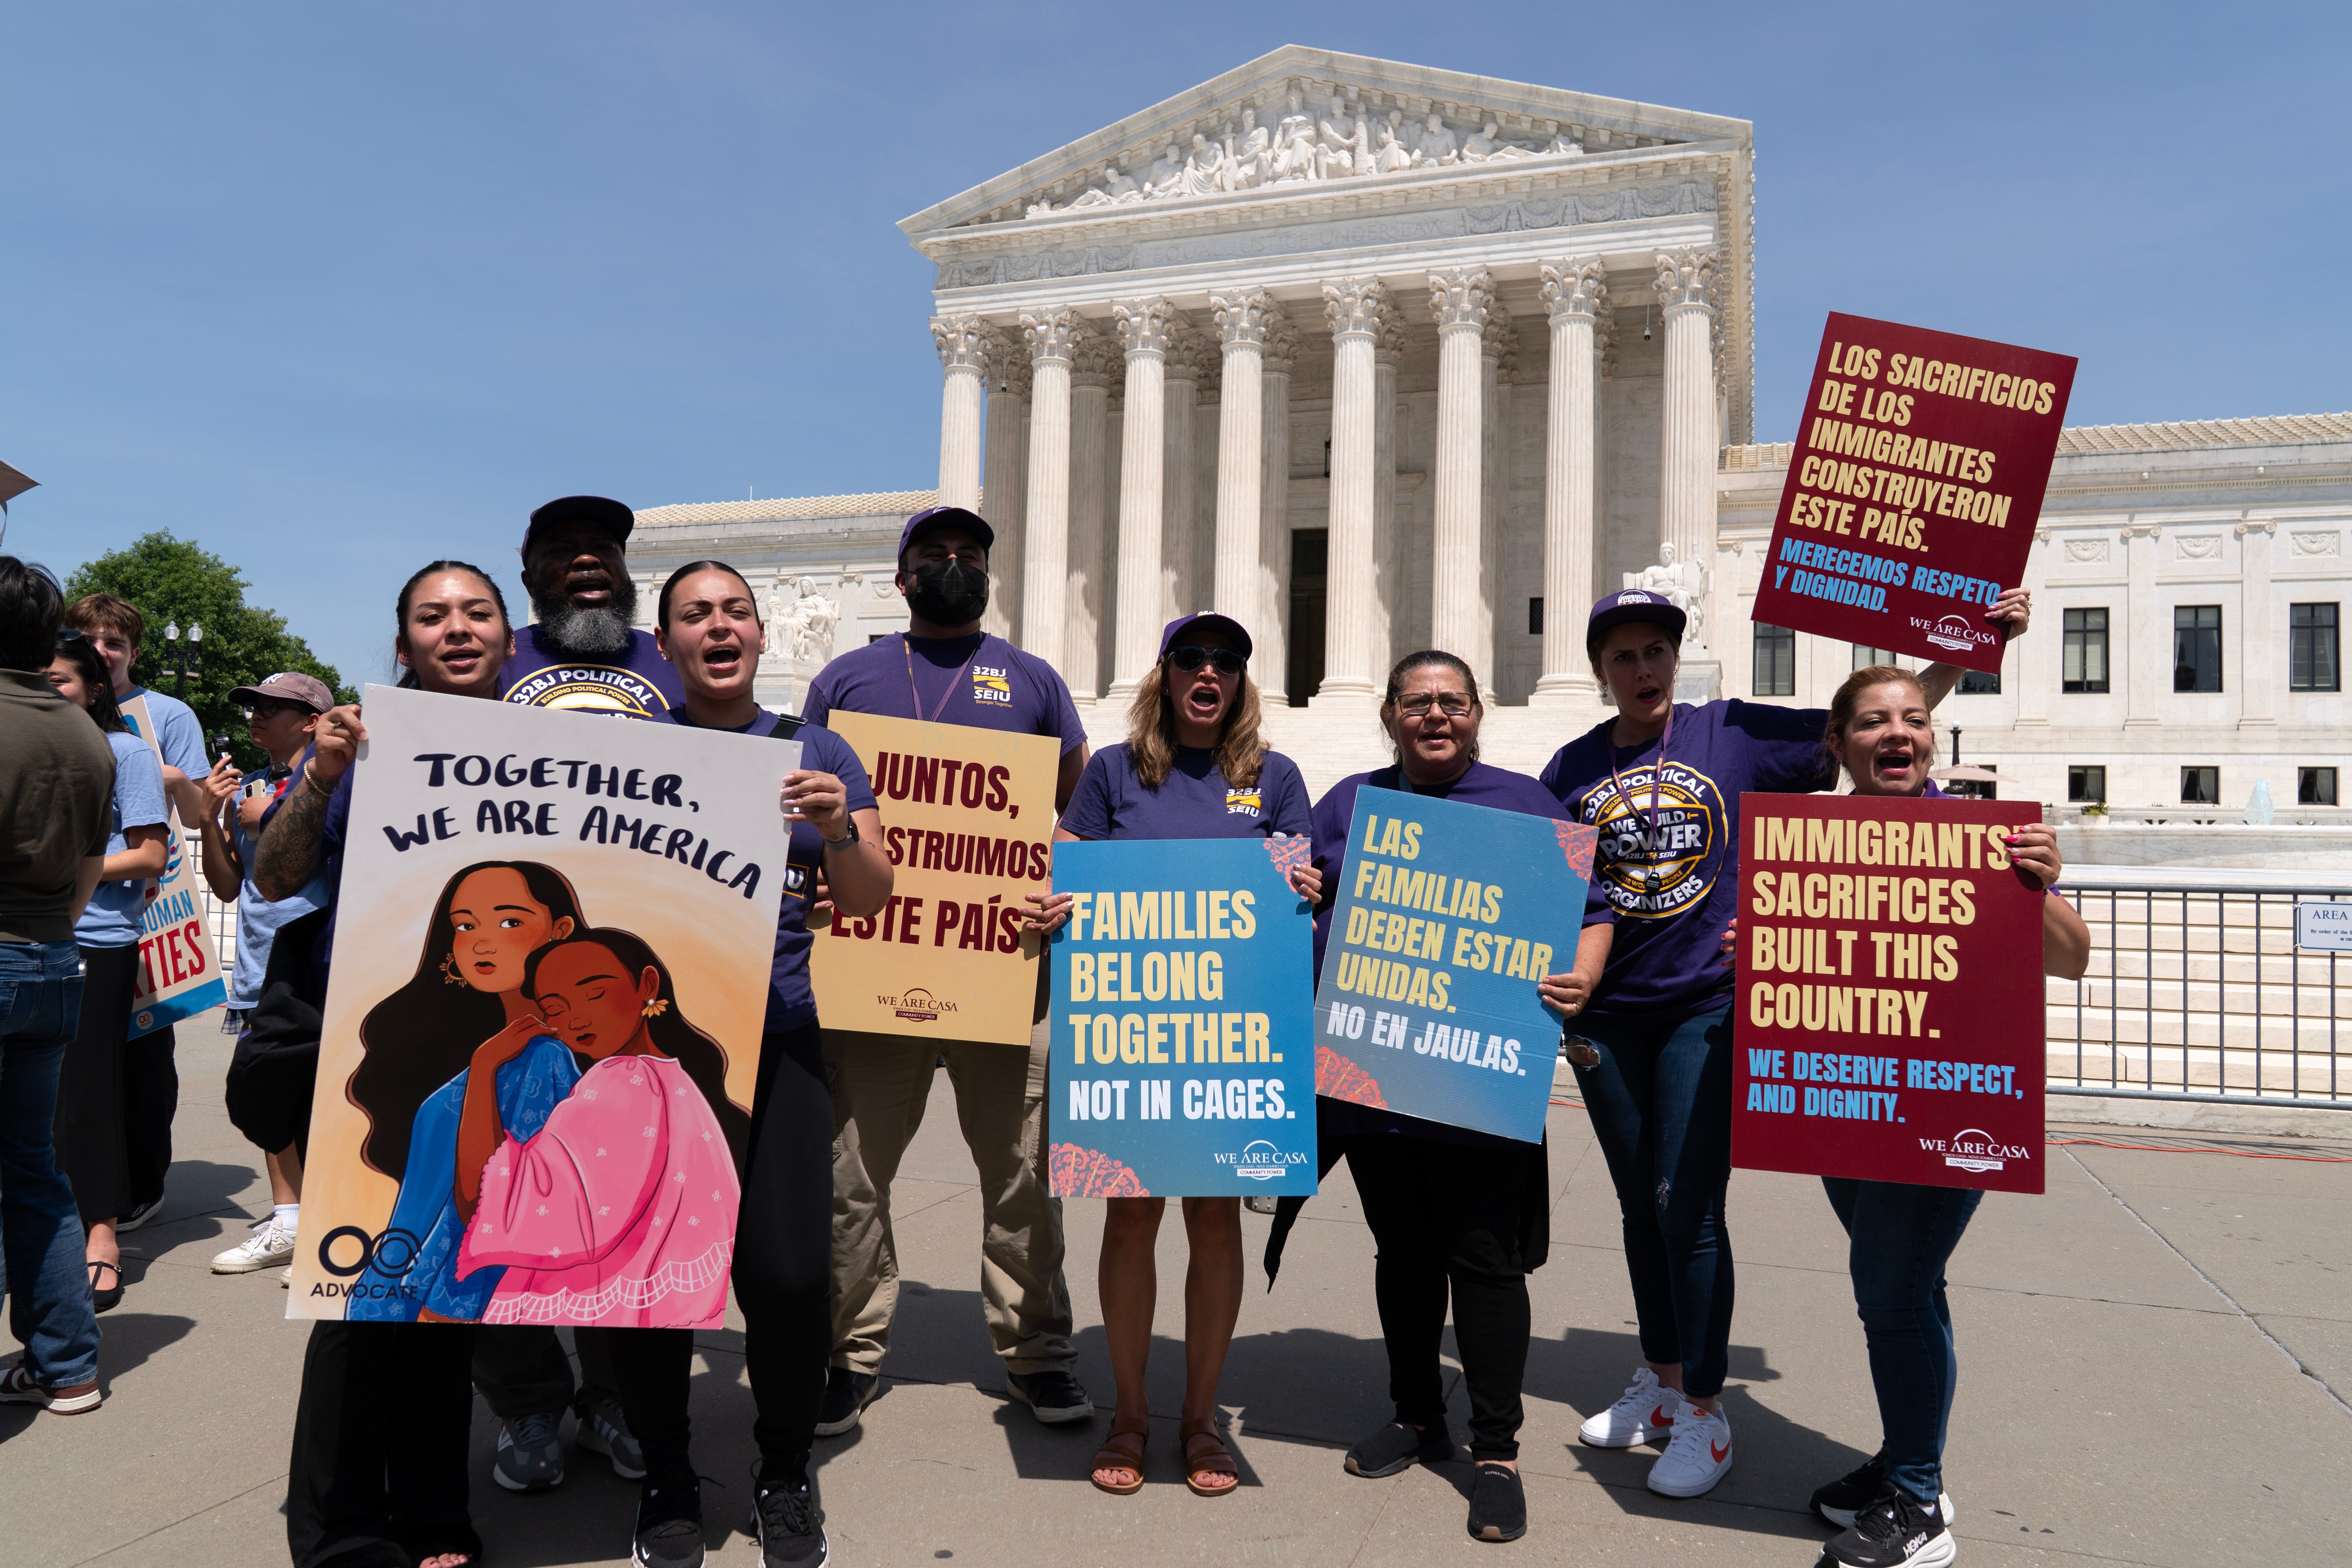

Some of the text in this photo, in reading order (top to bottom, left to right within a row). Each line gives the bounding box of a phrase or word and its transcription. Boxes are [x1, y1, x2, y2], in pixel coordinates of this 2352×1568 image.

[1155, 219, 1445, 263] EQUAL JUSTICE UNDER LAW
[1828, 342, 2056, 415] LOS SACRIFICIOS
[1818, 381, 1914, 427] DE LOS
[1808, 417, 1996, 484] INMIGRANTES
[1800, 455, 2012, 529] CONSTRUYERON
[1789, 493, 1929, 552] ESTE PAÍS.
[1774, 566, 1889, 613] Y DIGNIDAD.
[1780, 538, 2001, 606] MERECEMOS RESPETO
[1910, 617, 1996, 645] WE ARE CASA
[513, 669, 653, 705] 32BJ POLITICAL
[973, 666, 1006, 677] 32BJ
[541, 687, 572, 704] BUILDING
[607, 690, 631, 705] POWER
[974, 690, 1011, 702] SEIU
[413, 753, 699, 812] TOGETHER,
[868, 751, 1020, 819] JUNTOS,
[1226, 788, 1261, 797] 32BJ
[1586, 769, 1706, 819] 32BJ POLTICAL
[1663, 787, 1686, 801] POWER
[1227, 805, 1259, 818] SEIU
[1610, 818, 1636, 834] WE
[382, 807, 460, 852] WE
[477, 799, 560, 836] ARE
[580, 805, 761, 899] AMERICA
[1363, 814, 1422, 860] LAS
[1598, 824, 1702, 860] POWER
[1754, 816, 2020, 870] IMMIGRANTS
[1353, 860, 1502, 924] FAMILIAS
[1601, 874, 1703, 910] ORGANIZERS
[1620, 874, 1631, 884] FOR
[1661, 869, 1683, 885] PEOPLE
[1753, 871, 1976, 926] SACRIFICES
[934, 894, 1022, 954] PAÍS
[1071, 890, 1257, 941] FAMILIES
[2312, 910, 2348, 920] AREA
[135, 919, 205, 999] TIES
[1345, 906, 1553, 983] DEBEN ESTAR
[1752, 926, 1959, 982] BUILT THIS
[1071, 951, 1223, 1002] BELONG
[1336, 952, 1456, 1014] UNIDAS.
[877, 995, 958, 1012] WE ARE CASA
[1750, 982, 1941, 1038] COUNTRY.
[1069, 1012, 1283, 1065] TOGETHER.
[1326, 1001, 1526, 1077] NO EN JAULAS.
[1748, 1049, 2023, 1099] WE DESERVE RESPECT,
[1069, 1079, 1295, 1121] NOT IN CAGES.
[1747, 1083, 1906, 1123] AND DIGNITY.
[1214, 1152, 1308, 1164] WE ARE CASA
[1919, 1139, 2030, 1159] WE ARE CASA
[310, 1282, 418, 1300] ADVOCATE
[1903, 1531, 1928, 1559] HOKA
